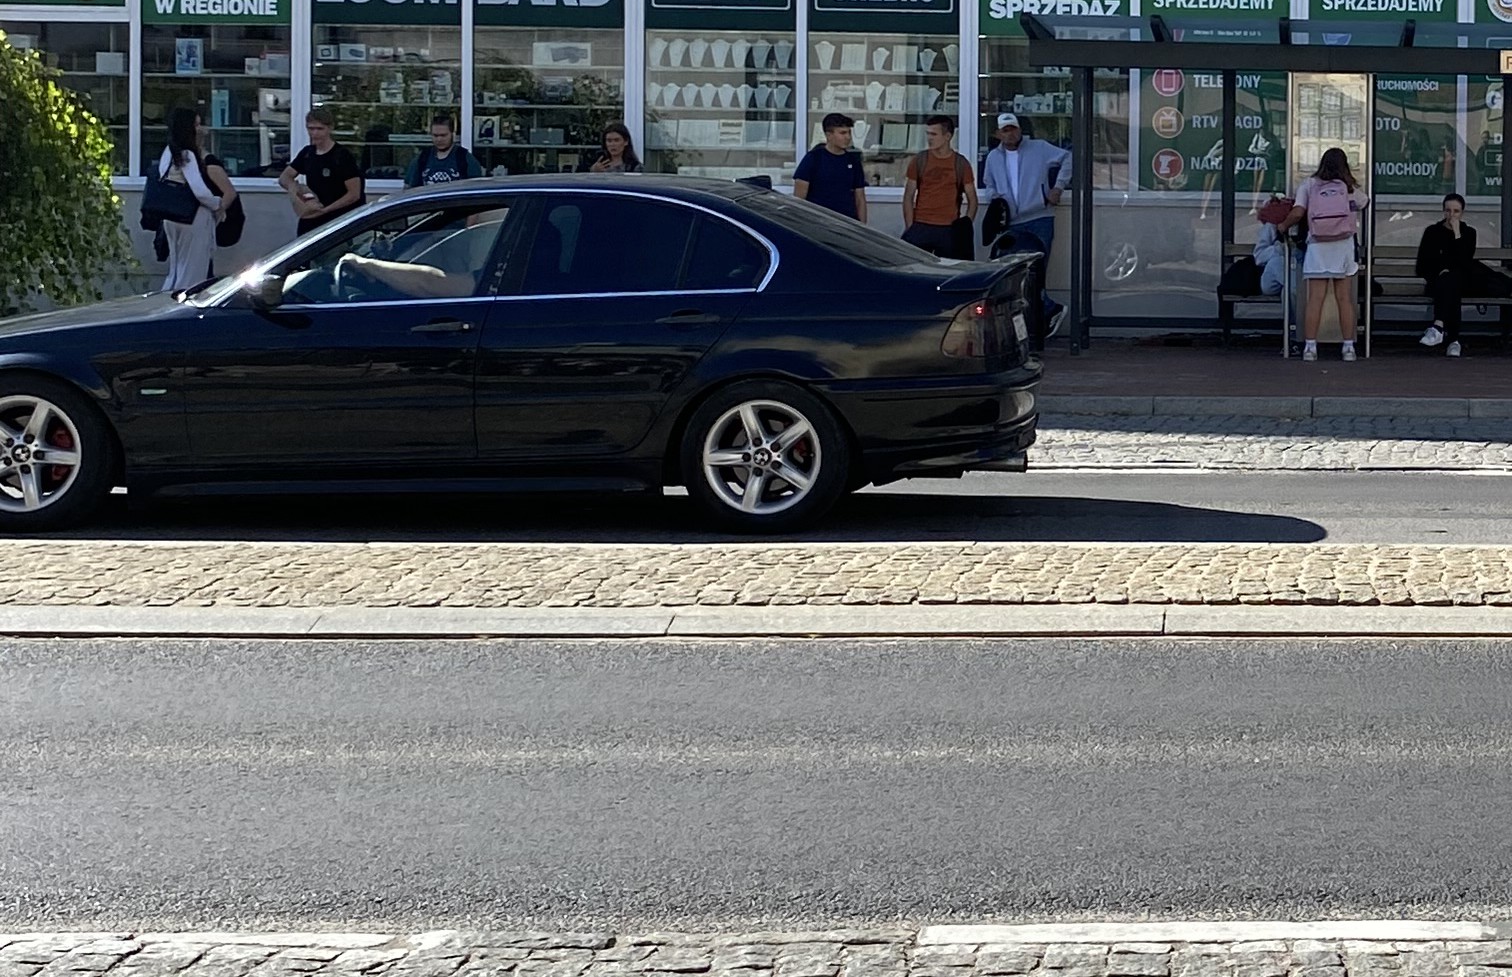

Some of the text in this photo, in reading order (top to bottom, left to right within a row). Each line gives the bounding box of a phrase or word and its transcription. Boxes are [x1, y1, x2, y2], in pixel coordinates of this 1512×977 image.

[1193, 74, 1261, 89] TELEONY
[1192, 115, 1263, 129] RTV AGD
[1376, 117, 1401, 131] OTO
[1375, 162, 1438, 176] MOCHODY
